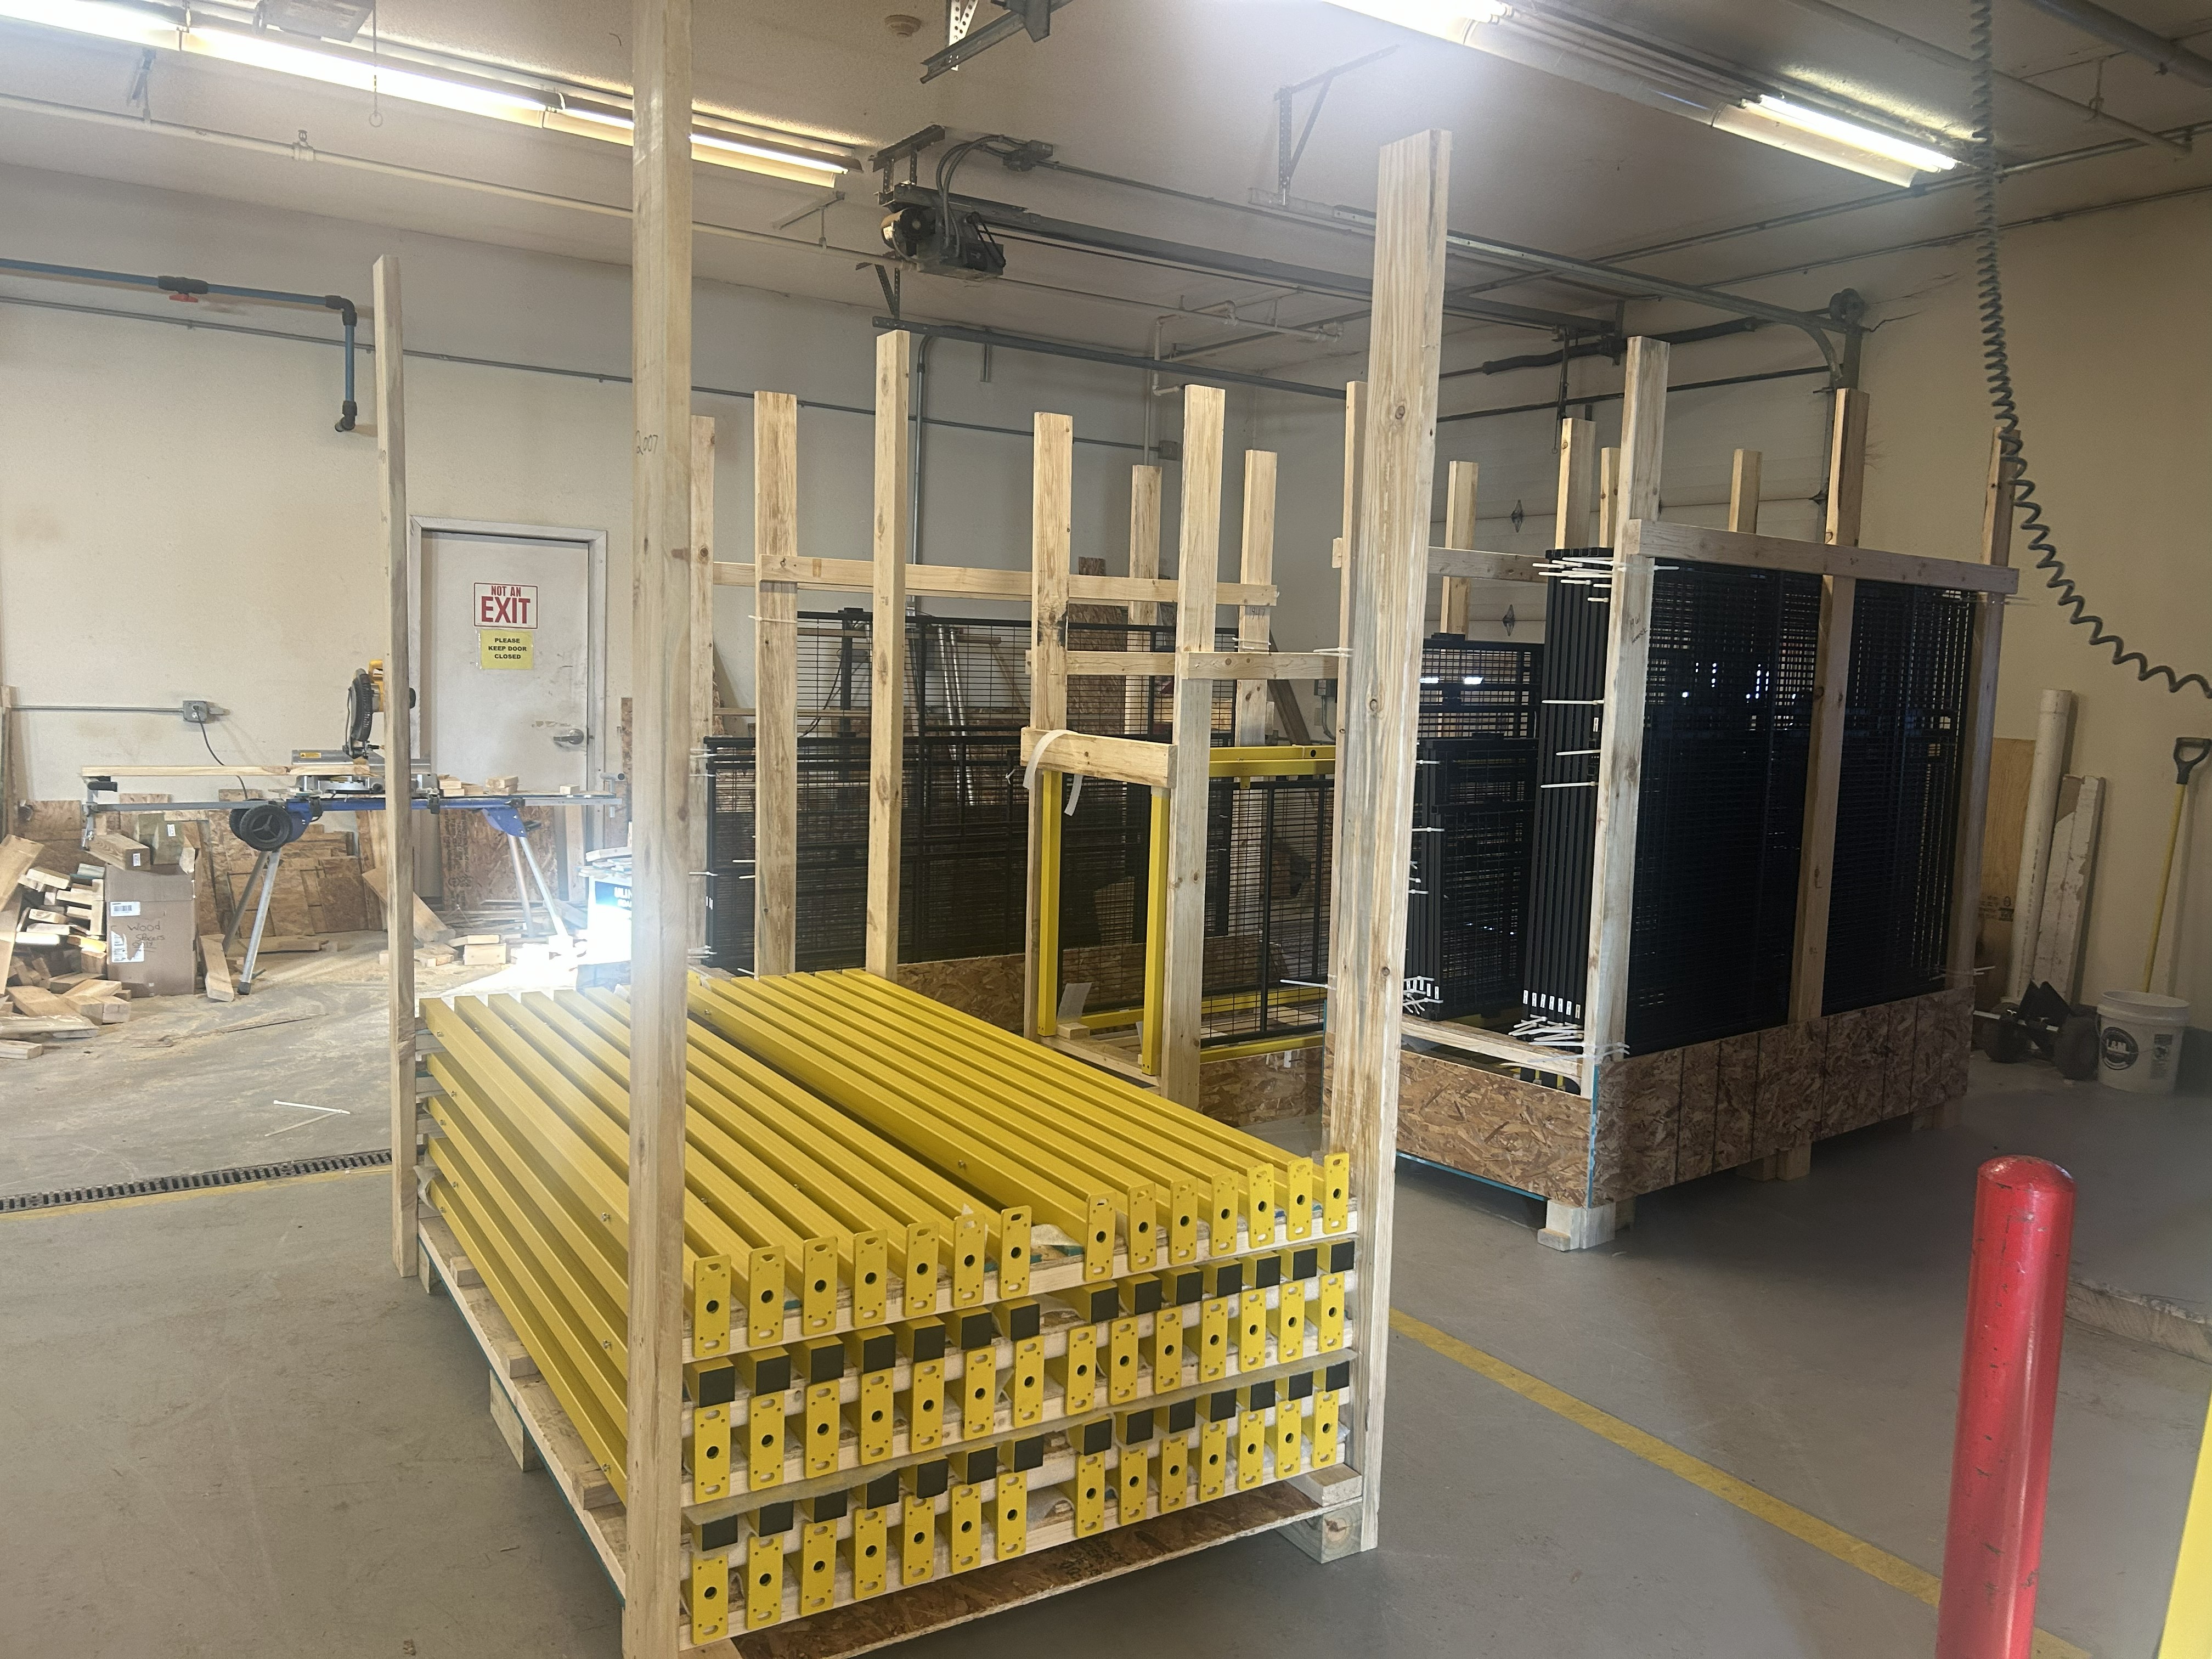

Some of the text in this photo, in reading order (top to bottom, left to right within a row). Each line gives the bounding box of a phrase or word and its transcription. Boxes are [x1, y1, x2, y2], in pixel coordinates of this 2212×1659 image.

[491, 585, 521, 597] NOT AN
[481, 596, 531, 624] EXIT
[614, 887, 631, 899] ULIN
